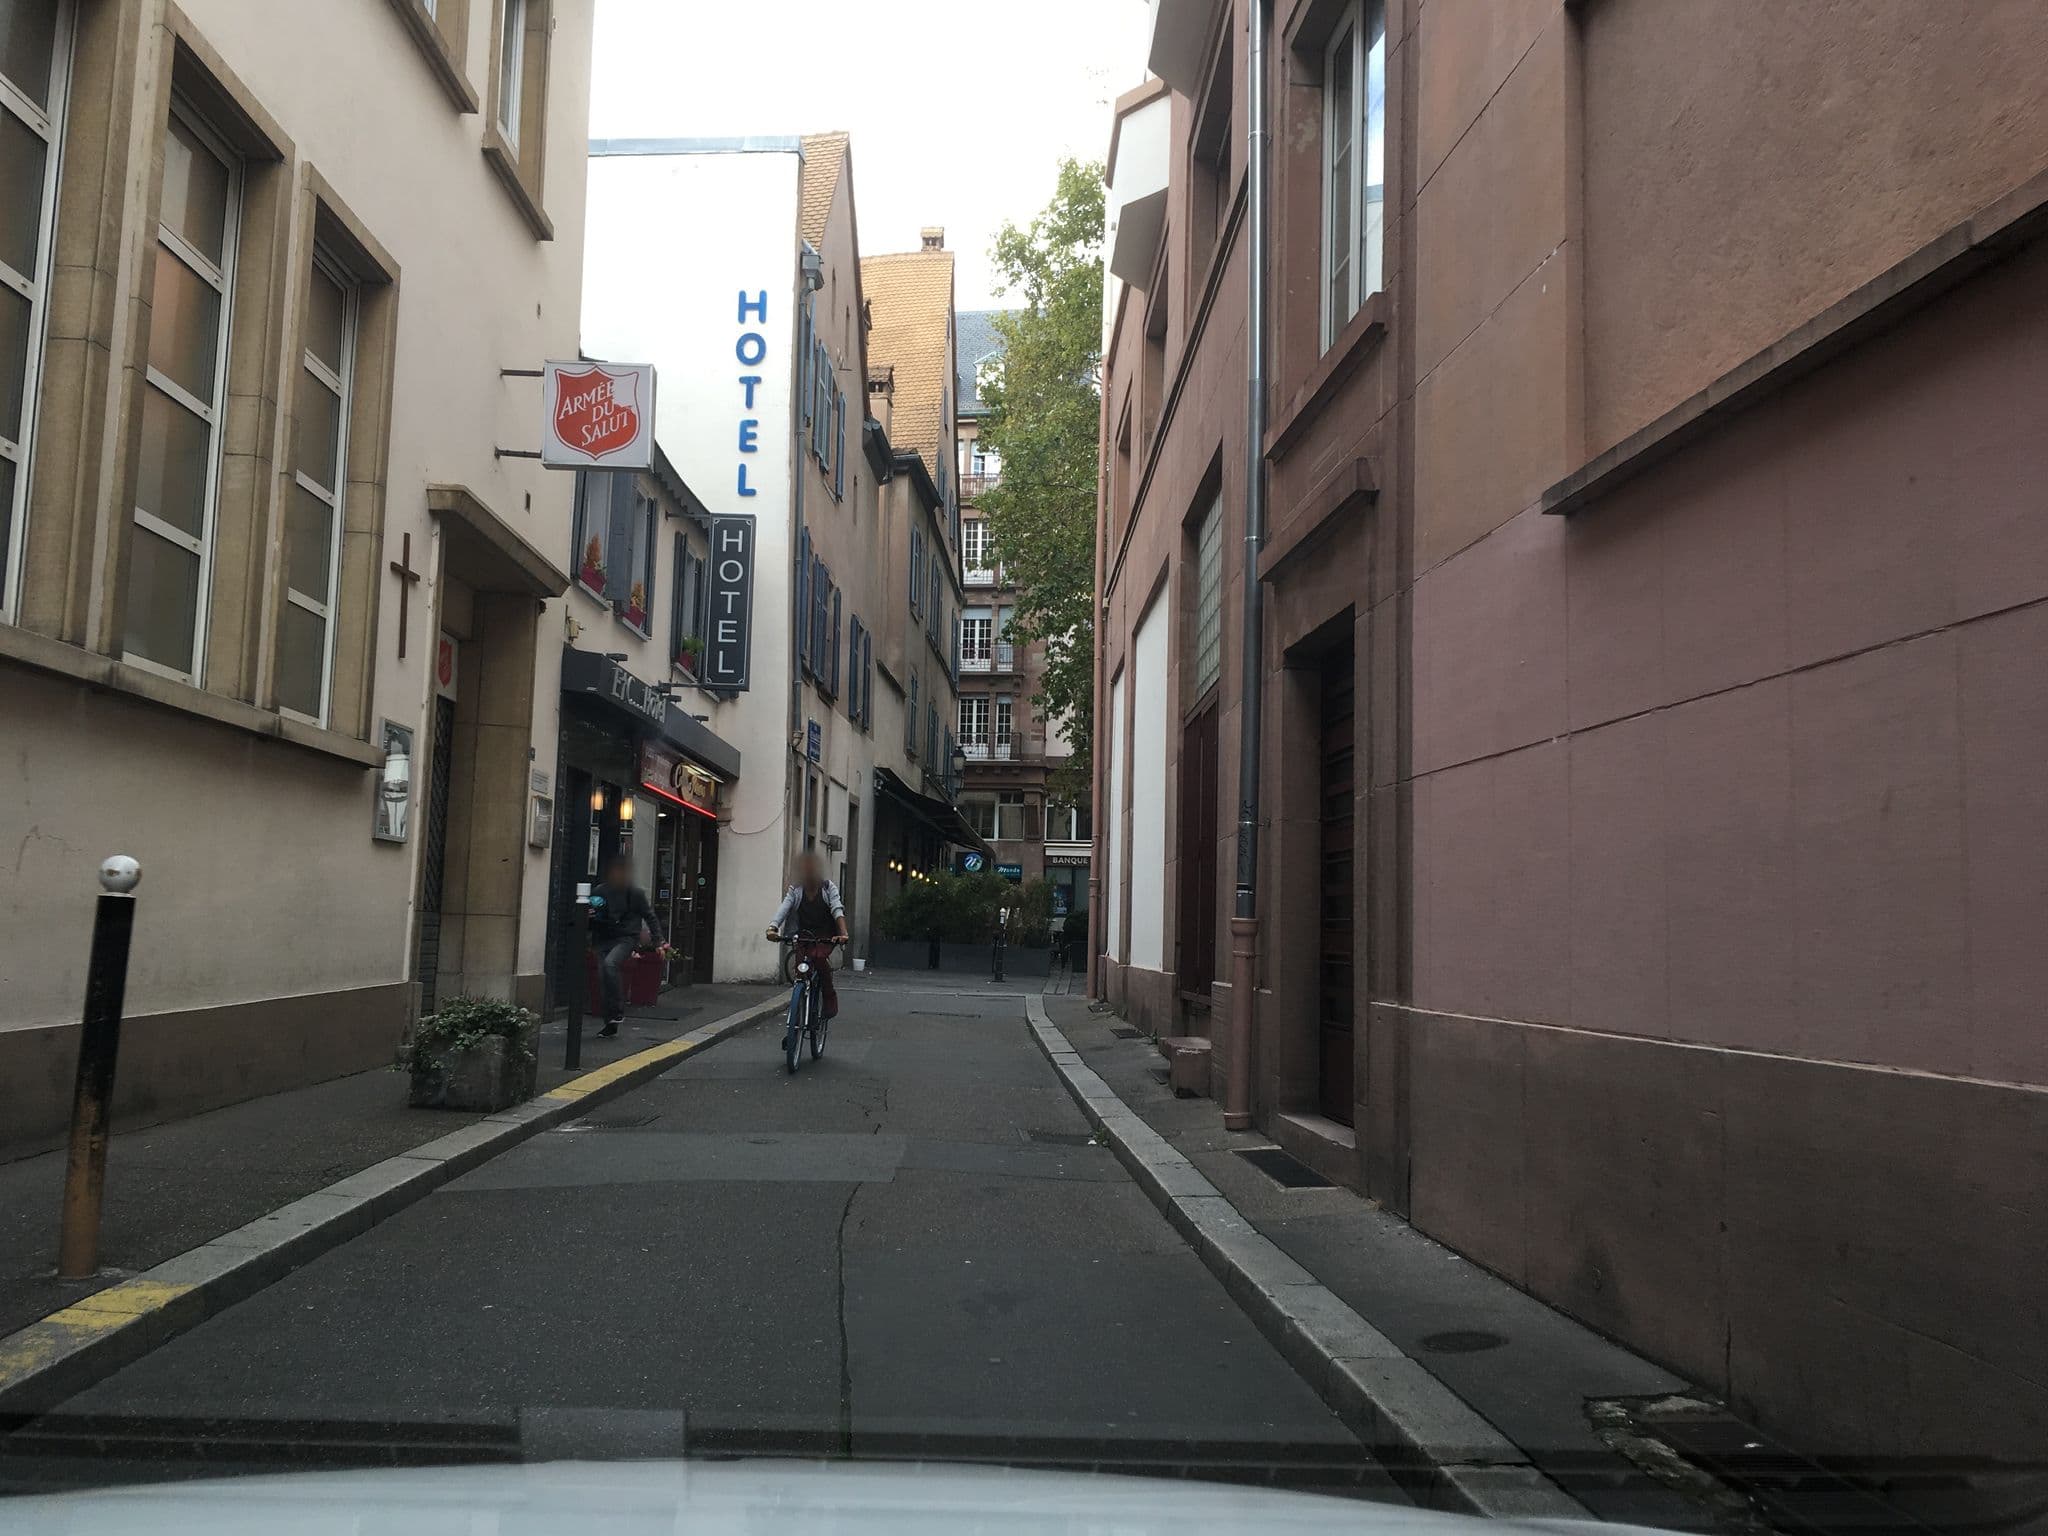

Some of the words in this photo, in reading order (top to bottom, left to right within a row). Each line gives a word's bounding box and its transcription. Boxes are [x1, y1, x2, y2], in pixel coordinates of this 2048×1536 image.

[558, 380, 616, 420] ARMÉE
[592, 398, 616, 423] DU
[736, 289, 767, 497] HOTEL
[581, 411, 629, 447] SALUT
[718, 529, 744, 674] HOTEL
[1052, 856, 1089, 865] BANQUE
